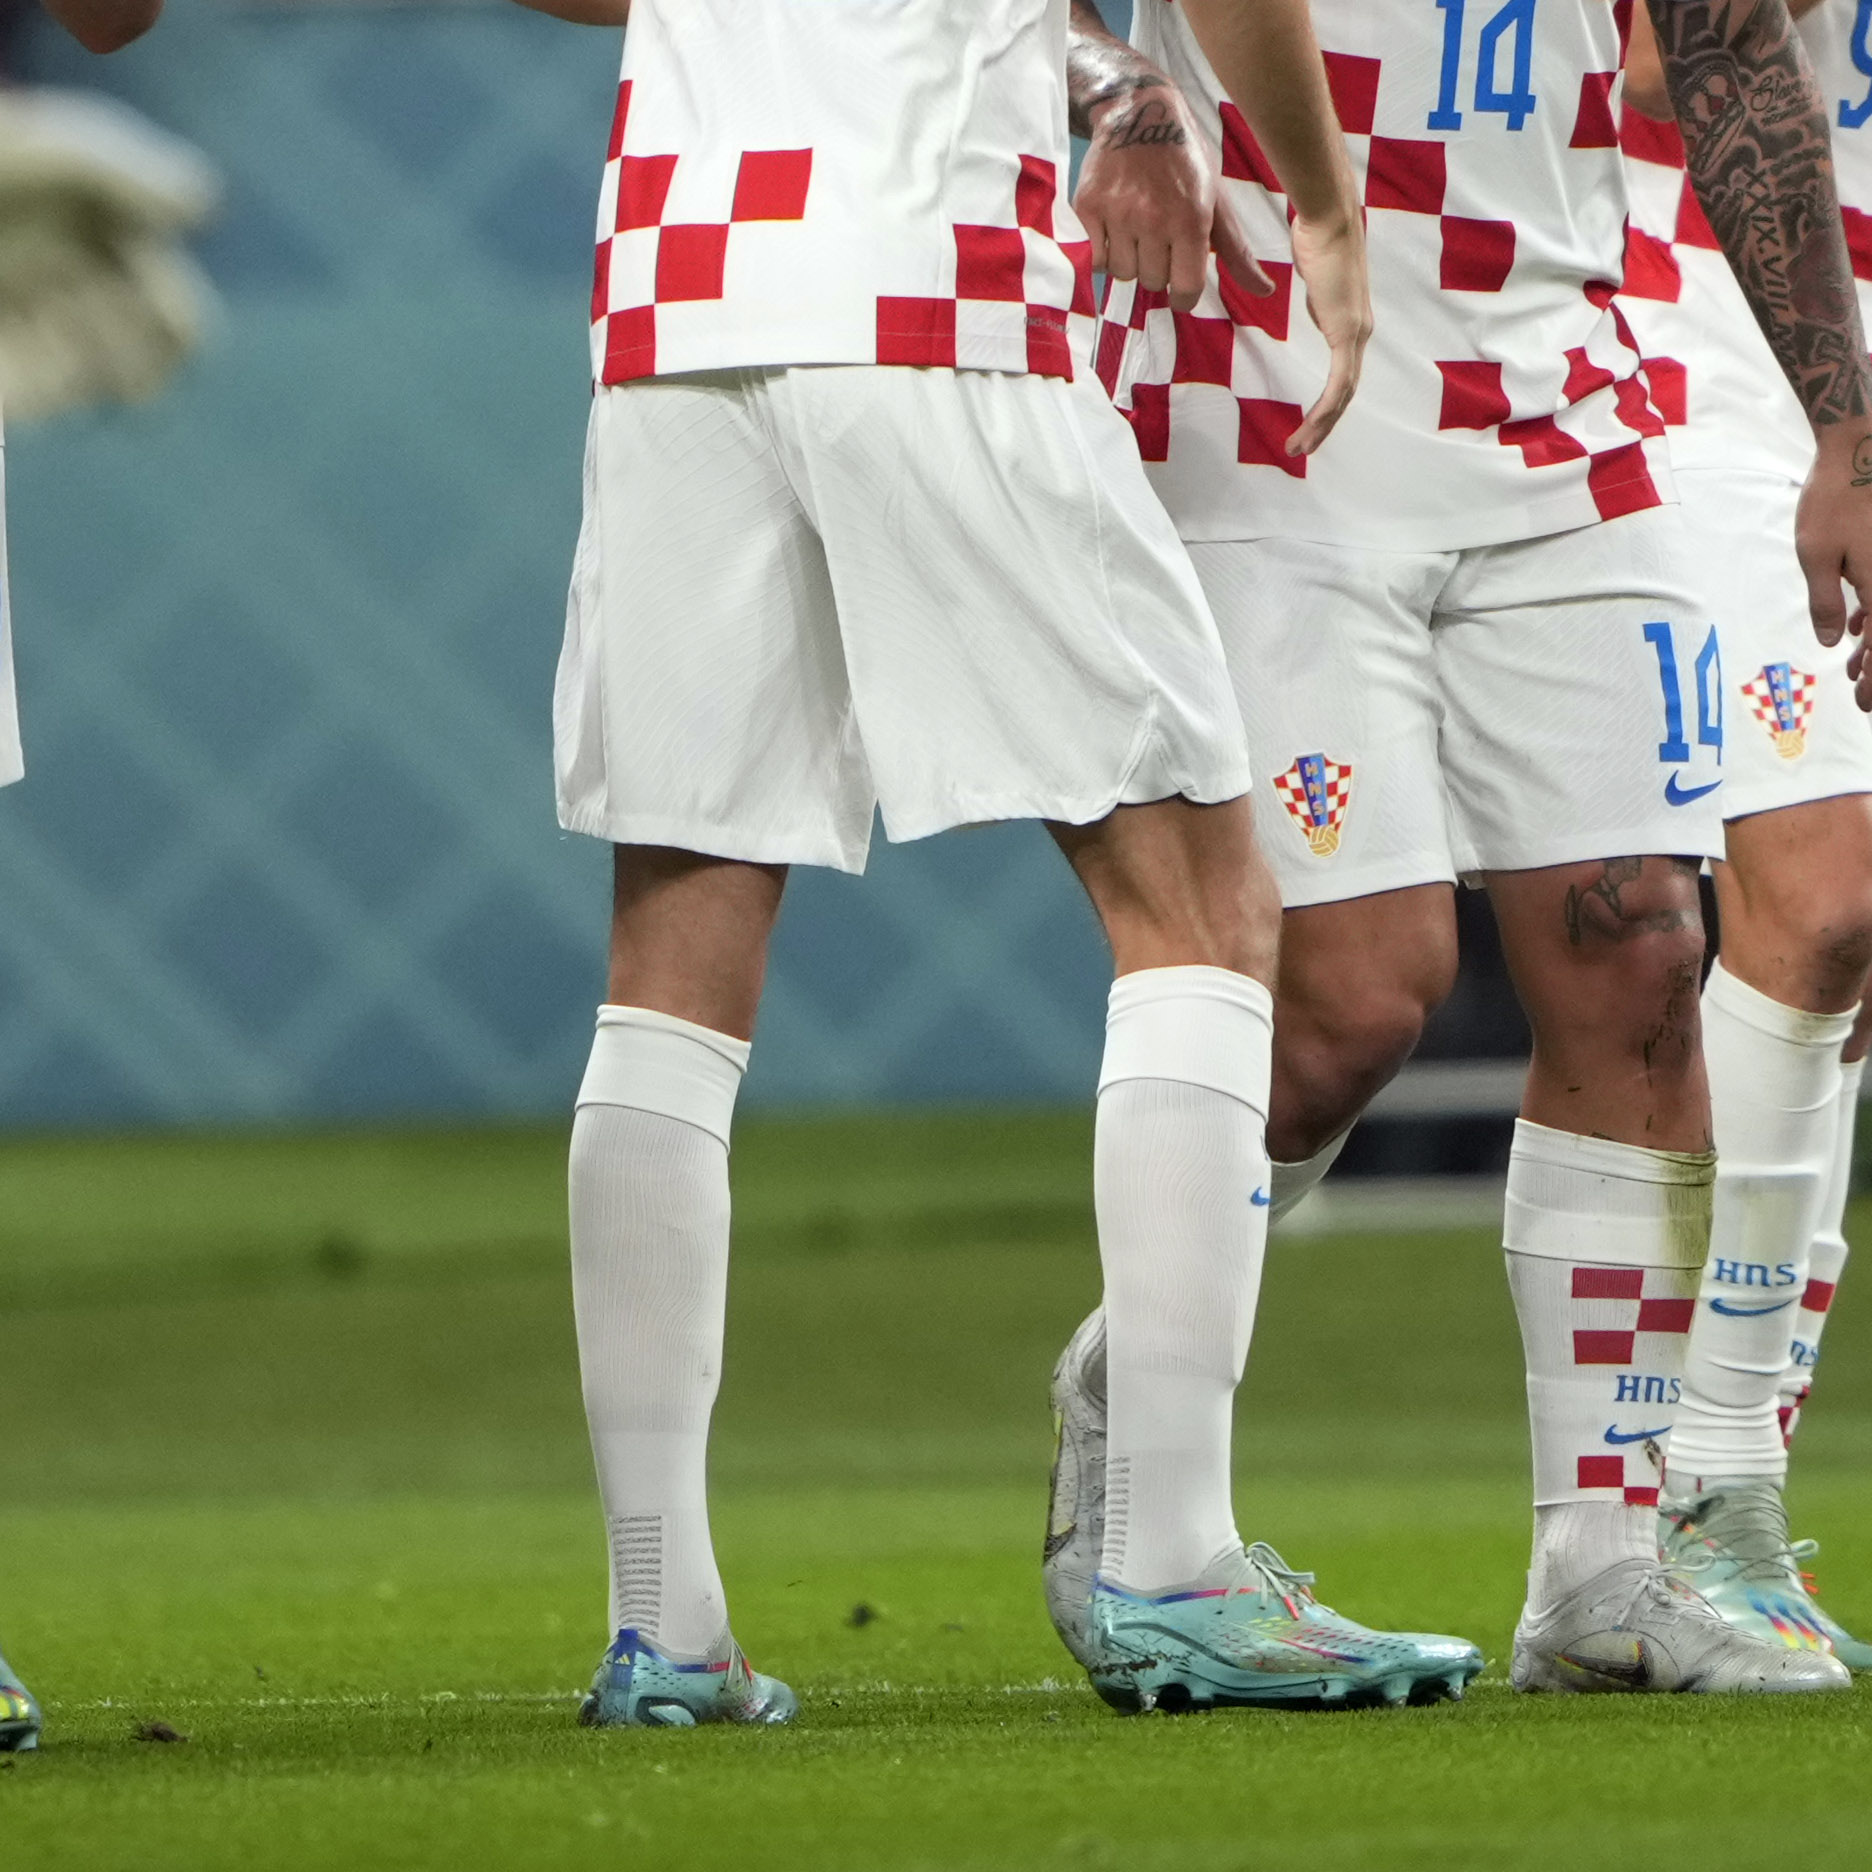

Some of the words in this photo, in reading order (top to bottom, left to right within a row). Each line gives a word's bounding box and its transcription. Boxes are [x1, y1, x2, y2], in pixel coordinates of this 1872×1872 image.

[1304, 762, 1325, 816] HNS
[1713, 1258, 1797, 1288] HNS
[1790, 1340, 1820, 1367] NS
[1614, 1375, 1681, 1405] HNS
